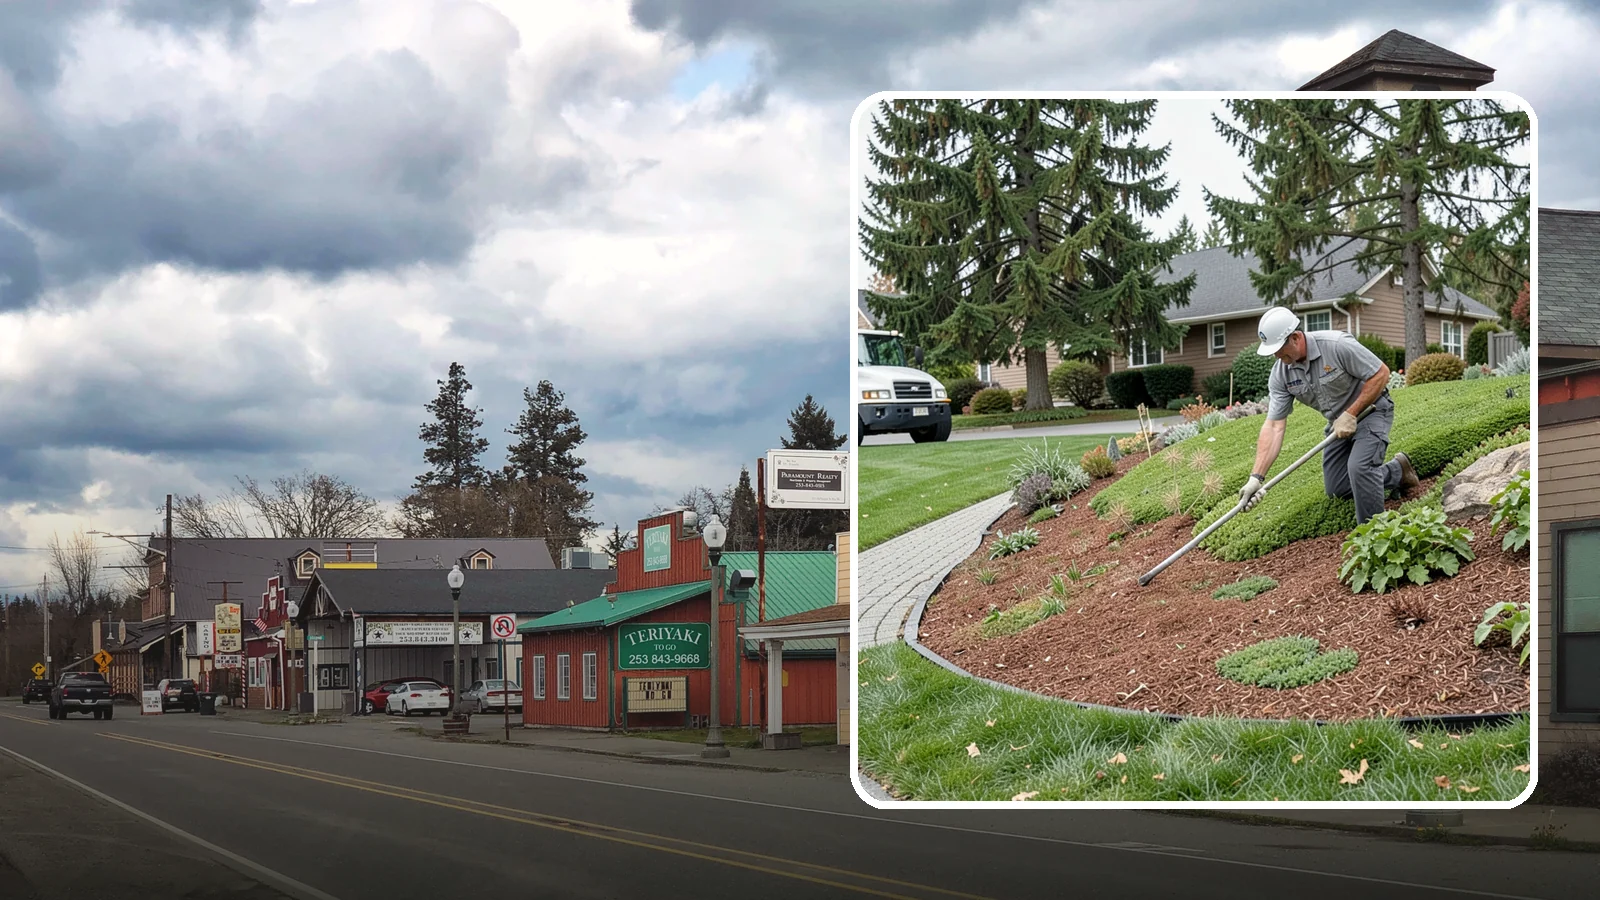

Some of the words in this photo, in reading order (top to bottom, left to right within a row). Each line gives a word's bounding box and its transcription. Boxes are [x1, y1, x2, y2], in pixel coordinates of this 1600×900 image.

[781, 471, 815, 479] PARAMOUNT
[624, 627, 702, 646] TERIYAKI
[628, 654, 649, 665] 253
[651, 653, 700, 664] 843-9668
